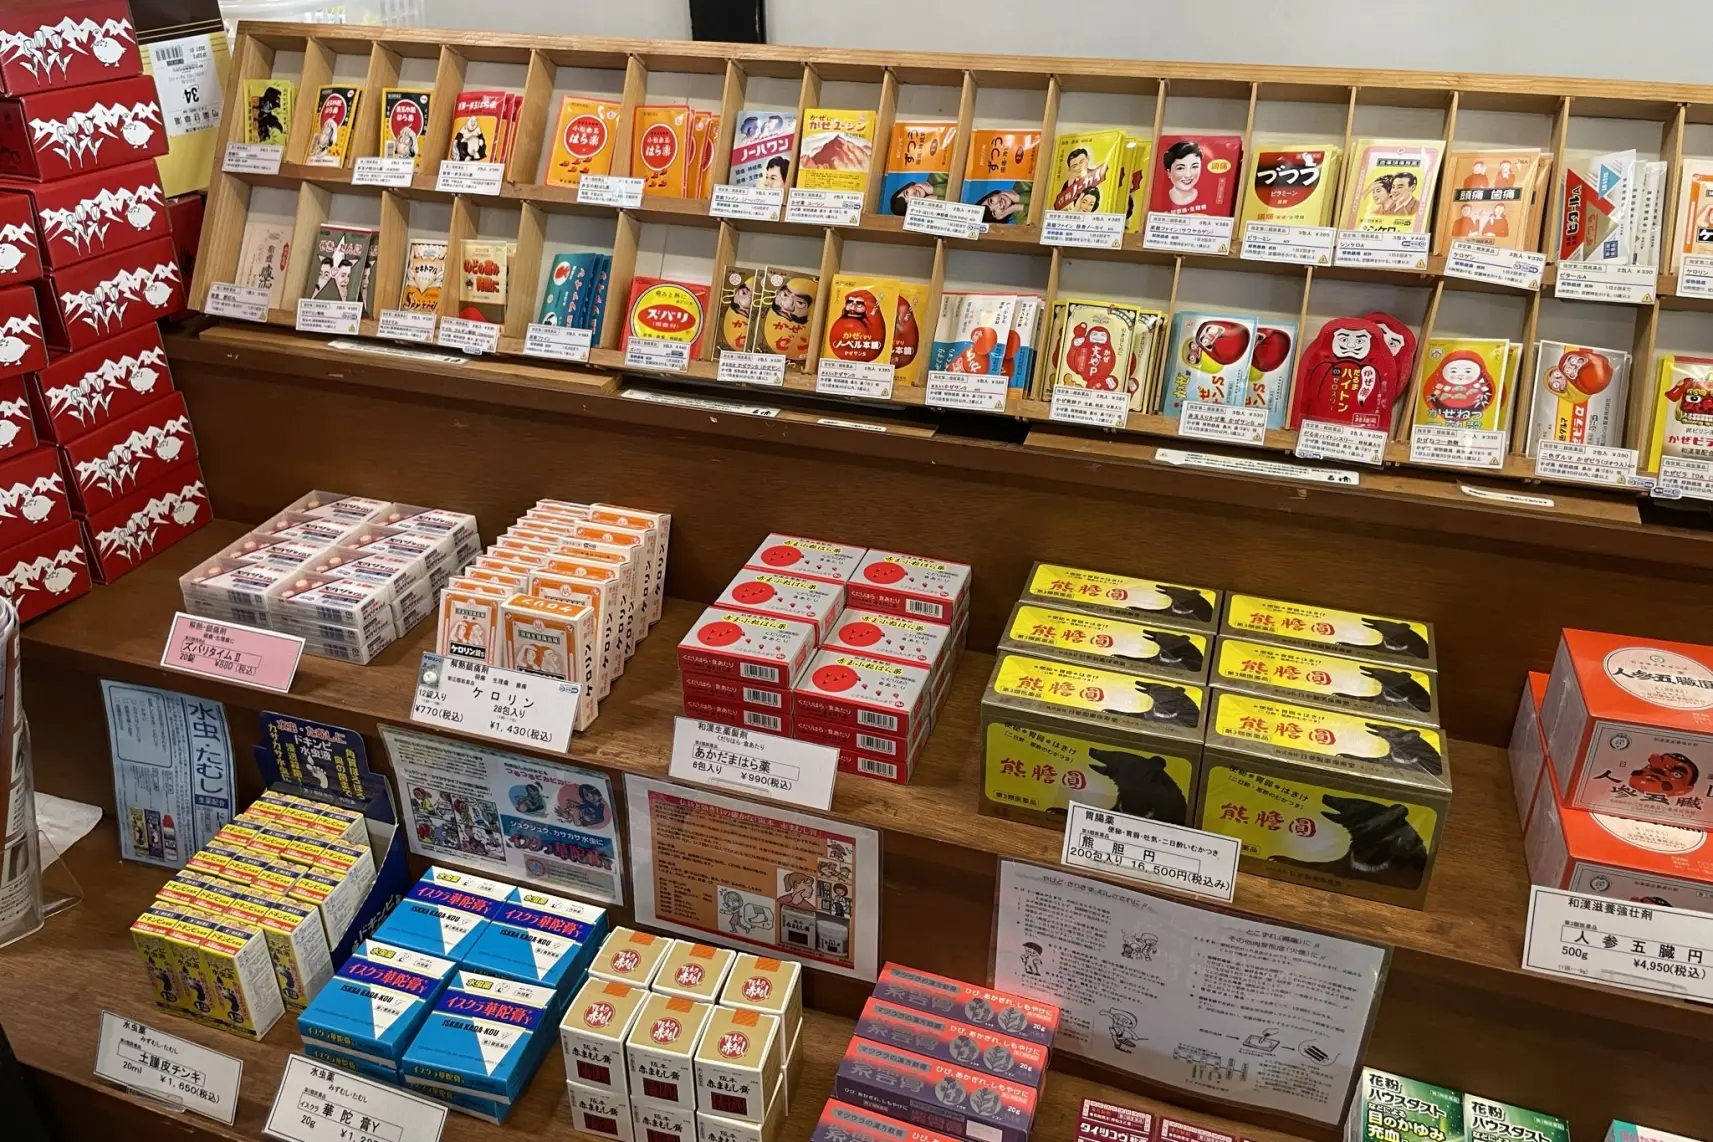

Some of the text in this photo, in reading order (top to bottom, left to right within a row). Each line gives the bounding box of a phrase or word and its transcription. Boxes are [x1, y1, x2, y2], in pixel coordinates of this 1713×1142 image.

[1460, 189, 1515, 201] 頭痛 歯痛
[647, 308, 689, 323] ズバリ
[1337, 368, 1353, 413] ハイトン
[183, 641, 232, 661] ズバリタイム
[450, 659, 489, 675] 解熱鎮痛剤
[415, 704, 464, 723] ¥770(税込)
[697, 722, 748, 740] 和漢生薬製剤
[188, 702, 224, 794] 水虫・たむし
[694, 747, 771, 773] あかだまはら薬
[692, 761, 792, 791] 6包入り ¥990(税込)
[1085, 811, 1115, 826] 胃腸薬
[1069, 846, 1124, 865] 200包入り
[1568, 897, 1653, 921] 和漢滋養強壮剤
[1561, 945, 1706, 980] 500g ¥4,950(税込)
[123, 1021, 146, 1035] 水虫薬
[1033, 1023, 1046, 1032] 20g
[123, 1061, 142, 1074] 20ml
[310, 1068, 336, 1082] 水虫薬
[1369, 1073, 1401, 1091] 花粉
[1007, 1106, 1021, 1115] 20g
[1368, 1089, 1447, 1118] ハウスダスト
[1368, 1103, 1407, 1118] などによる
[1471, 1101, 1504, 1119] 花粉
[301, 1115, 316, 1128] 20g
[1368, 1110, 1446, 1141] 目のかゆみ
[1368, 1125, 1400, 1142] 充血
